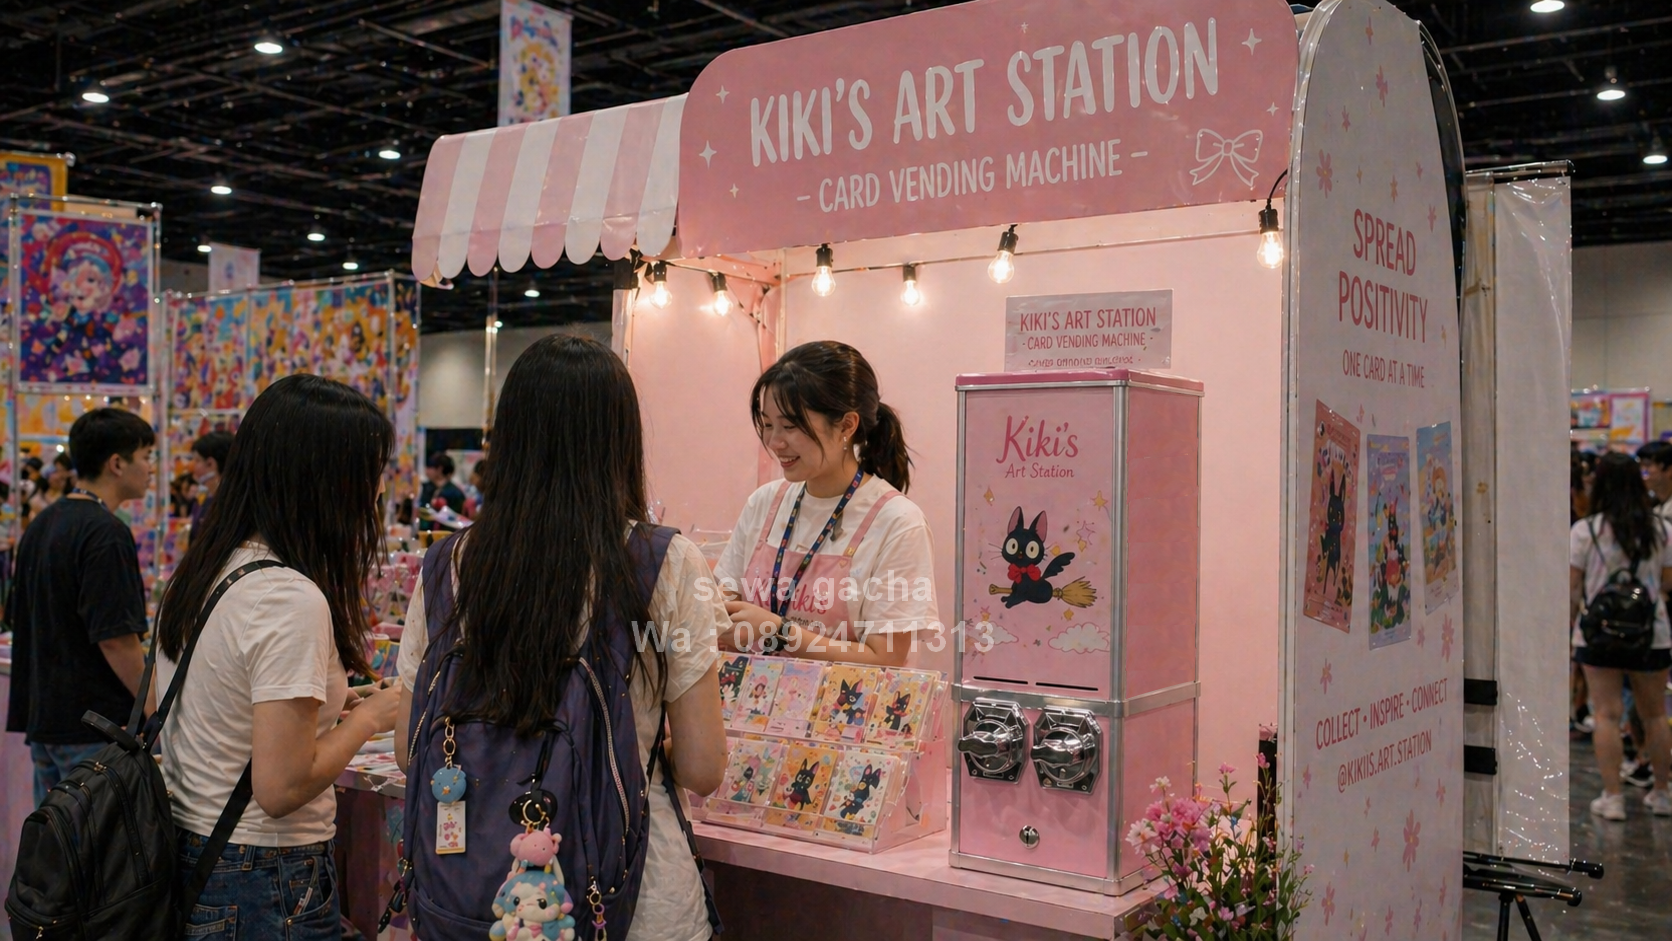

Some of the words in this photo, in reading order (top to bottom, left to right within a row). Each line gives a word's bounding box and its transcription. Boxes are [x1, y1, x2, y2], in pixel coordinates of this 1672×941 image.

[750, 77, 873, 167] KIKI'S
[893, 58, 985, 144] ART
[1006, 17, 1220, 127] STATION
[818, 171, 881, 213] CARD
[888, 157, 995, 202] VENDING
[1005, 138, 1123, 189] MACHINE
[1353, 208, 1417, 276] SPREAD
[1020, 311, 1060, 332] KIKI'S
[1064, 309, 1092, 330] ART
[1096, 307, 1156, 329] STATION
[1339, 270, 1428, 343] POSITIVITY
[1027, 336, 1053, 350] CARD
[1056, 333, 1099, 349] VENDING
[1101, 332, 1146, 347] MACHINE
[1342, 349, 1361, 378] ONE
[1363, 354, 1386, 382] CARD
[1388, 360, 1398, 384] AT
[1399, 362, 1405, 385] A
[1407, 363, 1425, 388] TIME
[996, 415, 1078, 464] Kiki's
[1005, 463, 1027, 478] Art
[1030, 462, 1075, 479] Station
[1315, 707, 1361, 750] COLLECT
[1369, 693, 1405, 730] INSPIRE
[1411, 678, 1448, 713] CONNECT
